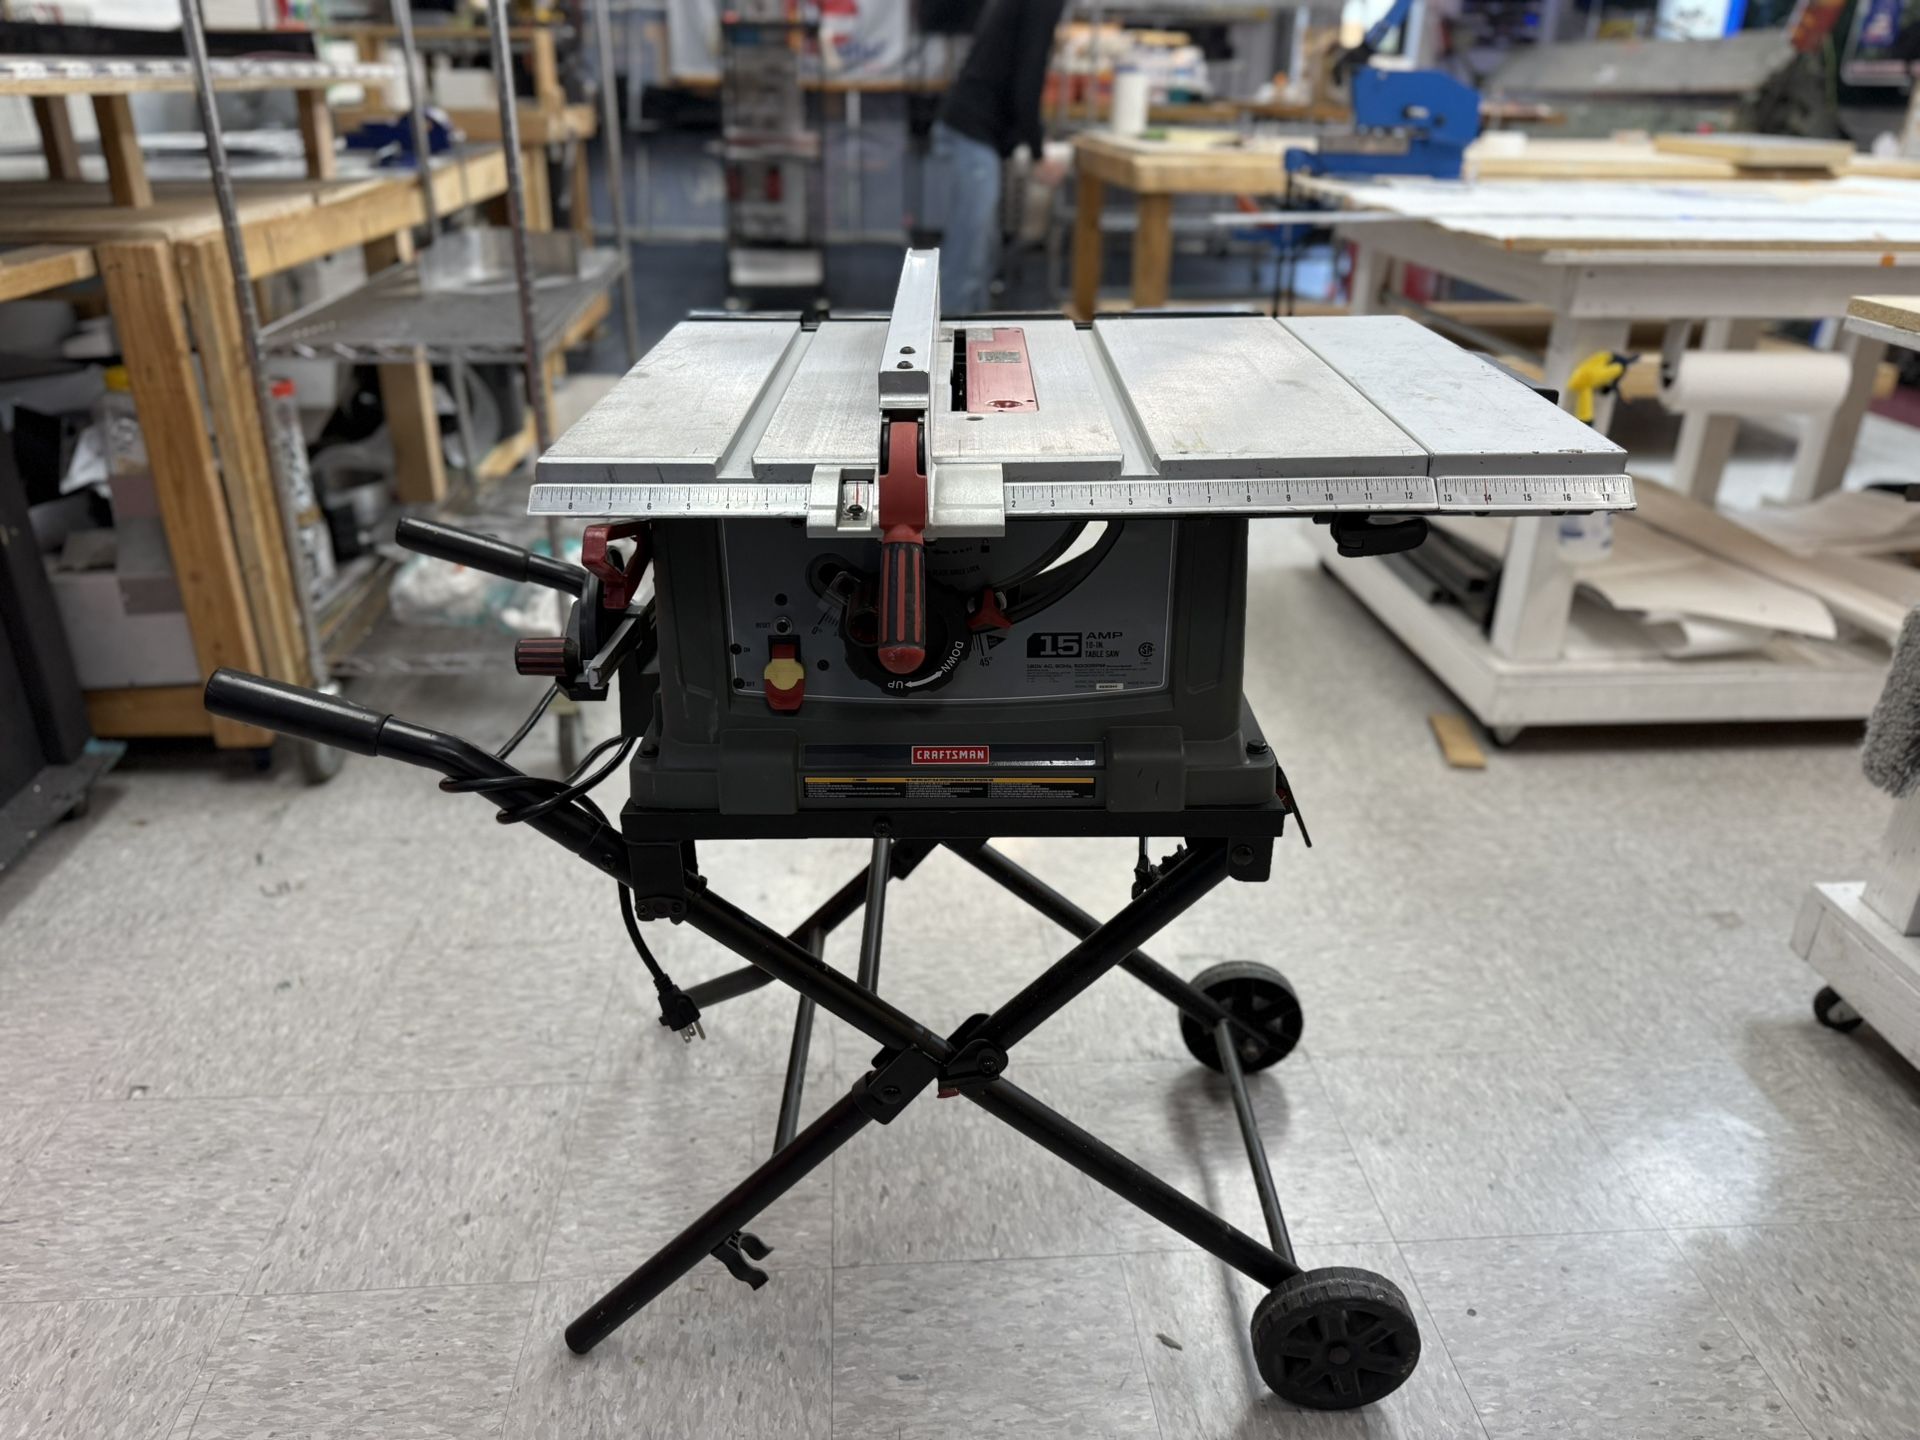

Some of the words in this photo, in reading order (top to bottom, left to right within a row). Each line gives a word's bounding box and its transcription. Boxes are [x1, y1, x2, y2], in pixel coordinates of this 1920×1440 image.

[1011, 500, 1016, 508] 2
[1050, 499, 1055, 507] 3
[1089, 498, 1094, 506] 4
[1128, 497, 1133, 506] 5
[1167, 496, 1173, 505] 6
[1207, 495, 1212, 504] 7
[1246, 494, 1252, 503] 8
[1286, 494, 1292, 502] 9
[1324, 493, 1334, 501] 10
[1364, 492, 1373, 500] 11
[1405, 491, 1413, 500] 12
[1443, 494, 1453, 502] 13
[1483, 493, 1492, 502] 14
[1523, 493, 1532, 502] 15
[1562, 493, 1572, 502] 16
[1601, 493, 1610, 502] 17
[567, 502, 573, 510] 8
[608, 502, 613, 510] 7
[646, 502, 652, 511] 6
[686, 502, 691, 510] 5
[725, 502, 731, 510] 4
[764, 502, 769, 510] 3
[803, 502, 810, 510] 2
[1040, 635, 1080, 656] 15
[1086, 632, 1123, 640] AMP
[940, 640, 964, 672] DOWN
[1085, 650, 1104, 658] TABLE
[1105, 650, 1120, 658] SAW
[979, 656, 993, 668] 45°
[887, 680, 904, 689] UP
[916, 750, 986, 761] CRAFTSMAN
